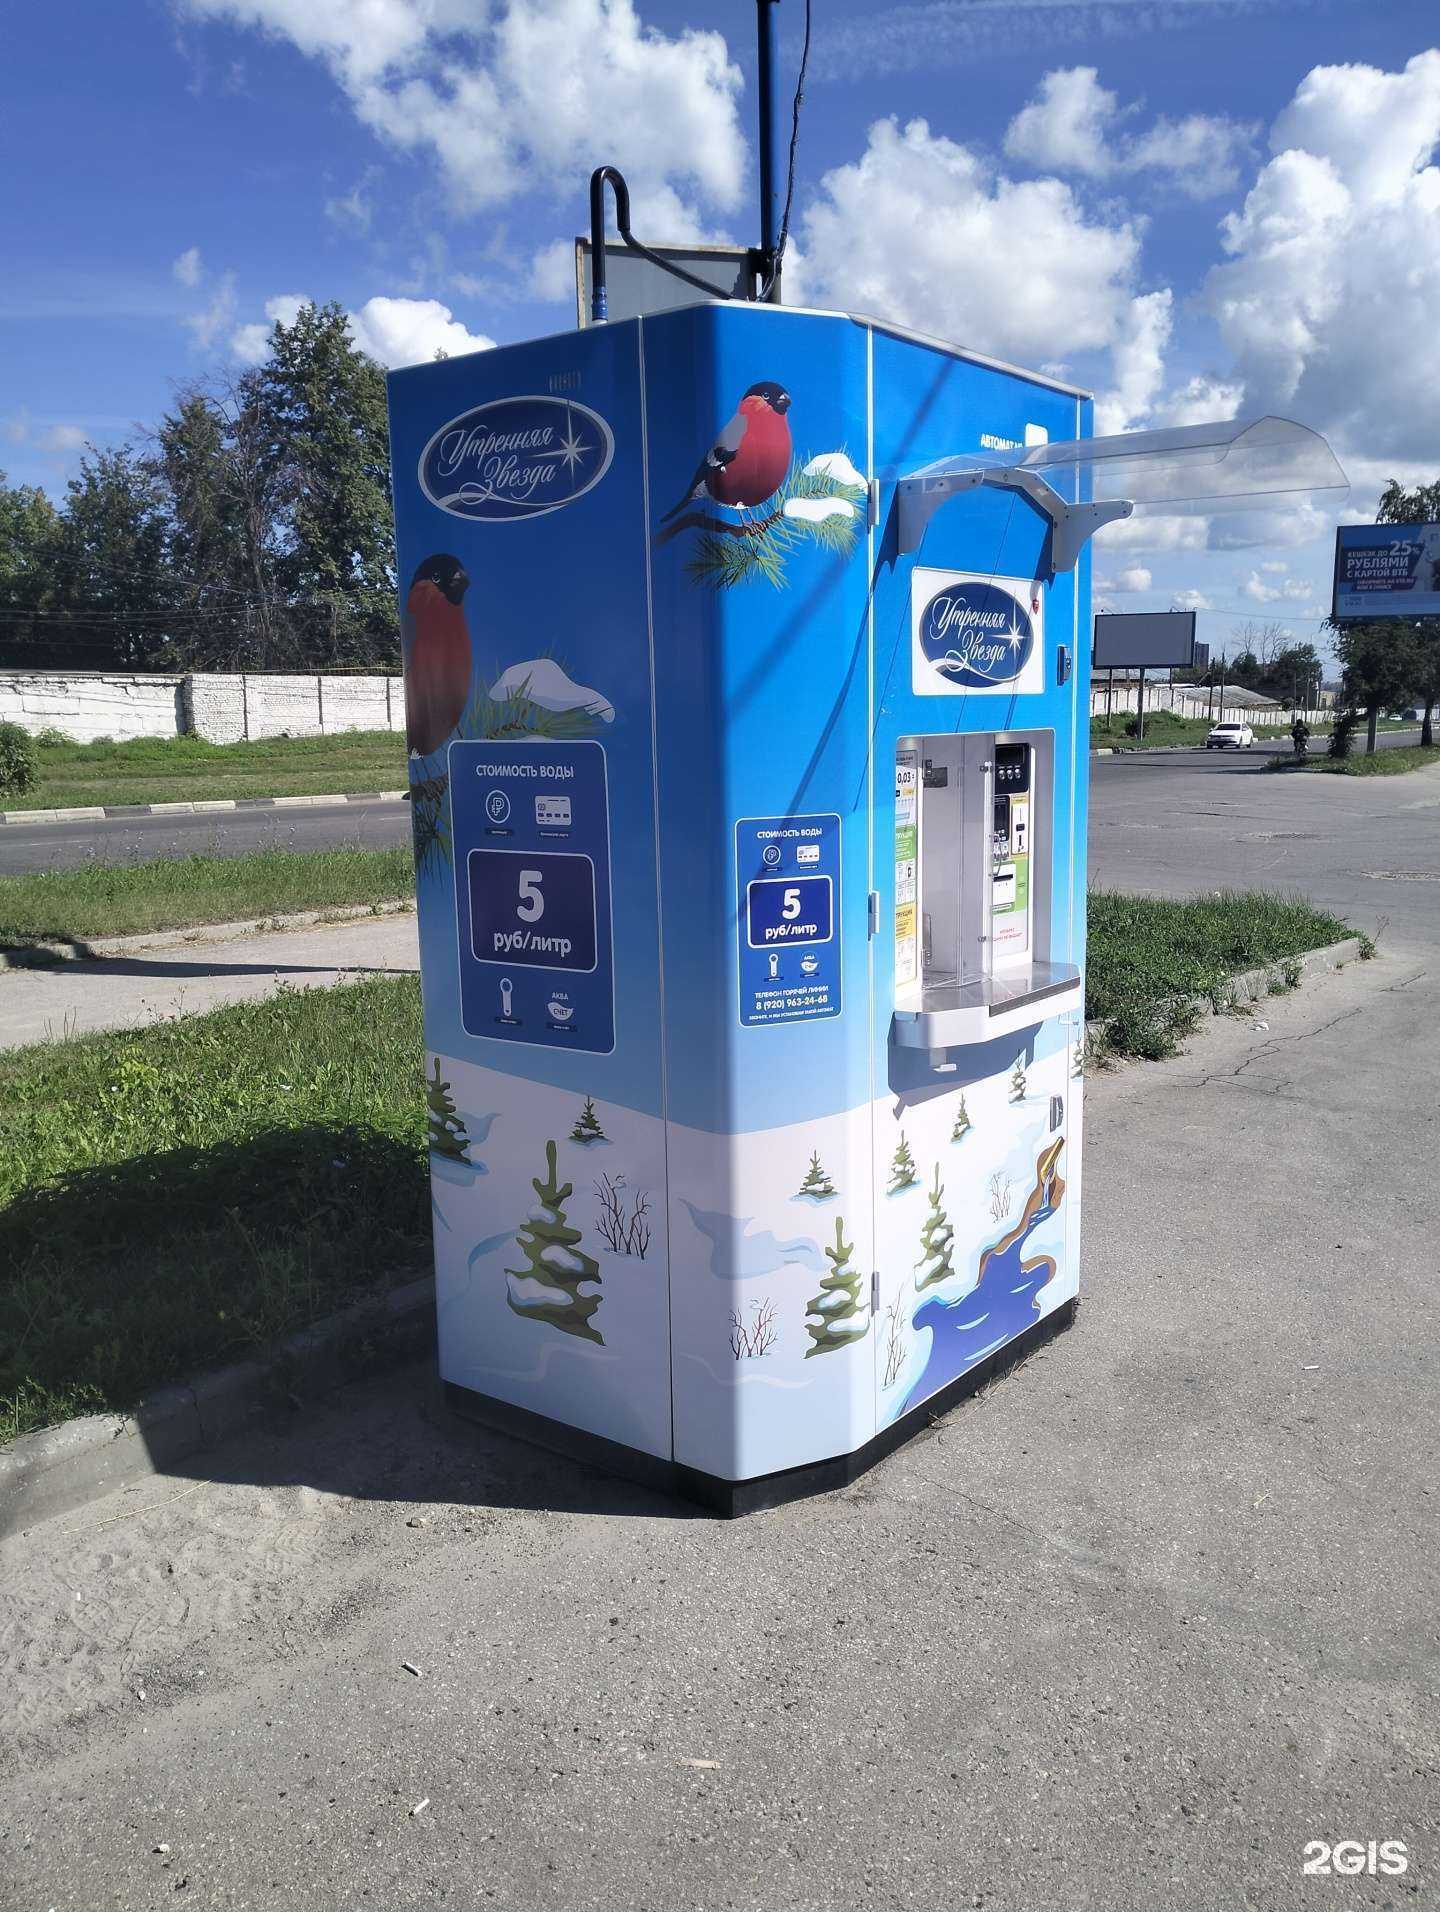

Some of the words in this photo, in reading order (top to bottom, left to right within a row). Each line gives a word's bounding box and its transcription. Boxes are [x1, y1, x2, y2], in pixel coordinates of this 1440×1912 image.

[438, 424, 555, 477] Утренняя
[459, 454, 557, 505] Звезда
[1347, 556, 1409, 569] РУБЛЯМИ
[1354, 567, 1390, 577] КАРТОЙ
[929, 596, 1007, 640] Утренняя
[944, 629, 1007, 673] Звезда
[475, 764, 538, 778] СТОИМОСТЬ
[539, 765, 575, 779] ВОДЫ
[757, 829, 800, 839] СТОИМОСТЬ
[801, 827, 823, 837] ВОДЫ
[516, 870, 545, 923] 5
[781, 888, 801, 920] 5
[765, 924, 818, 940] руб/литр
[493, 930, 572, 957] руб/литр
[754, 991, 783, 999] ТЕЛЕФОН
[755, 1001, 762, 1010] 8
[763, 999, 785, 1011] (920)
[786, 994, 828, 1007] 963-24-68
